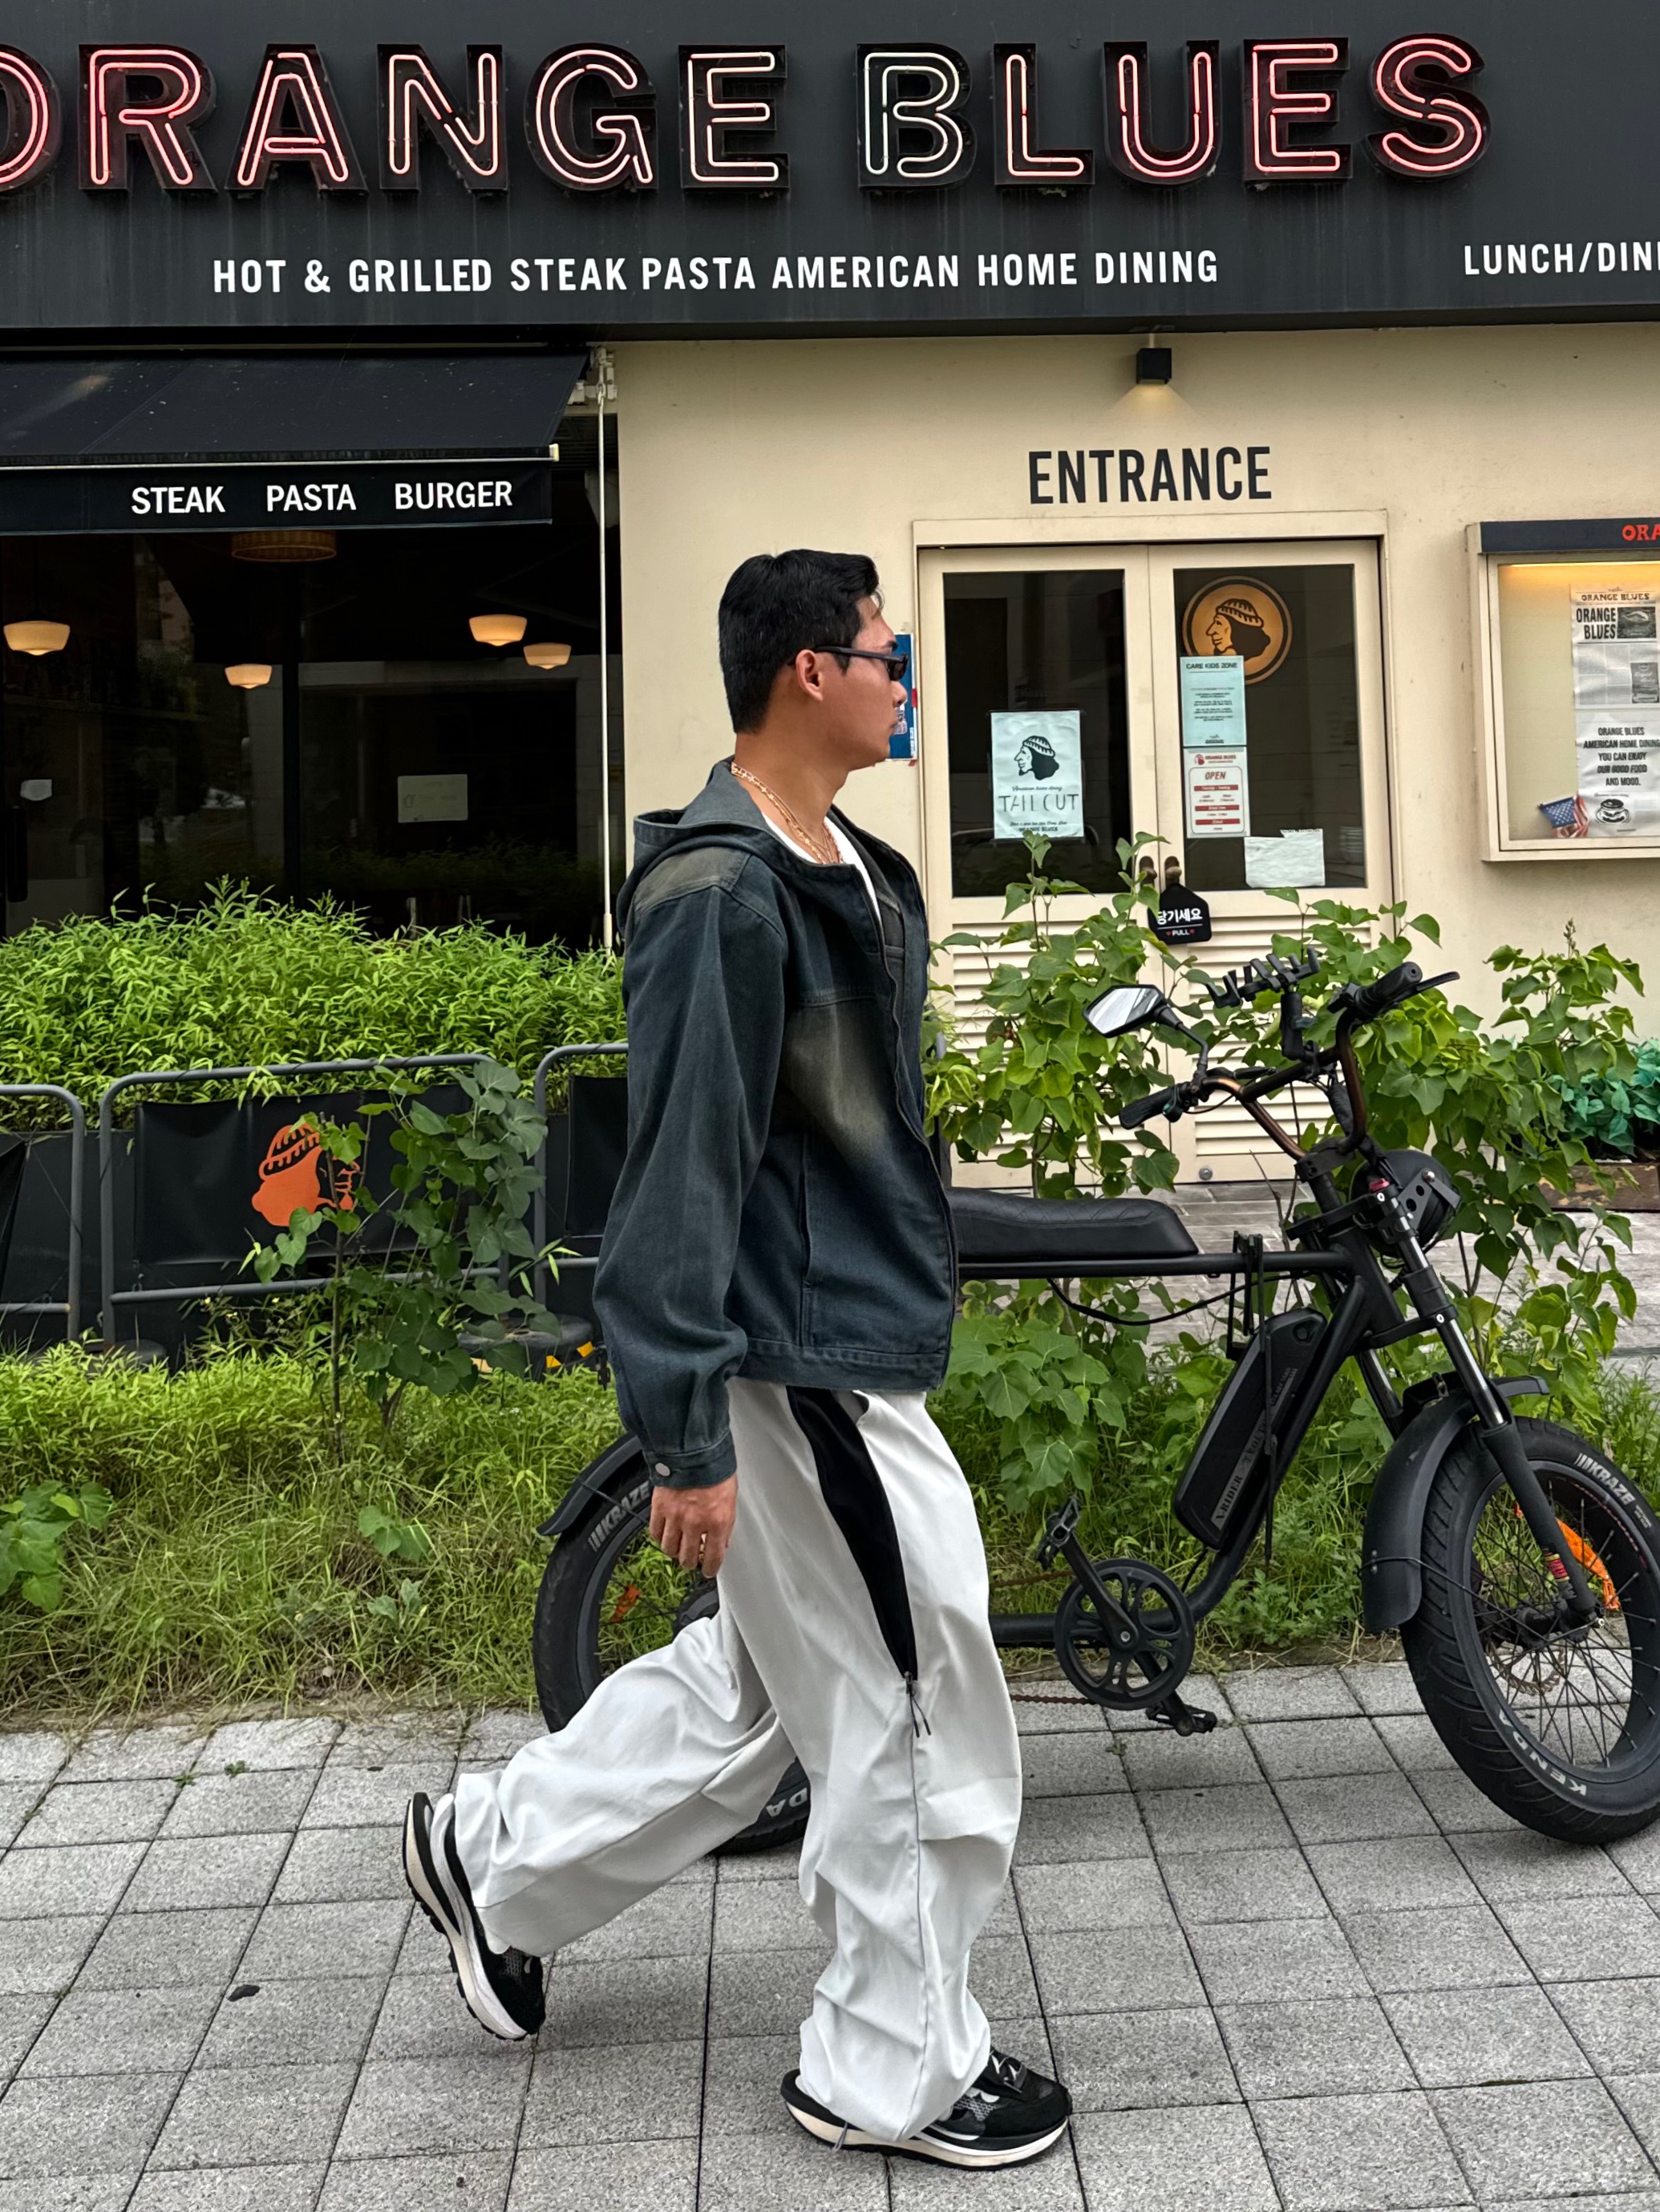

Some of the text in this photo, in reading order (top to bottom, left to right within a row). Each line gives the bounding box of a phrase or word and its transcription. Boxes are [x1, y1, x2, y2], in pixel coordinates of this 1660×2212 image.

[856, 34, 1488, 189] BLUES
[1464, 241, 1660, 275] LUNCH/DIN
[213, 249, 1217, 294] HOT & GRILLED STEAK PASTA AMERICAN HOME DINING
[1029, 446, 1272, 504] ENTRANCE
[132, 480, 512, 515] STEAK PASTA BURGER
[1576, 607, 1616, 623] ORANGE
[1584, 623, 1616, 640] BLUES
[1597, 727, 1645, 735] ORANGE BLUES
[1583, 739, 1618, 748] AMERICAN
[1618, 739, 1638, 748] HOME
[1597, 752, 1648, 761] YOU CAN ENJOY
[1205, 772, 1226, 780] OPEN
[1597, 765, 1611, 774] OUR
[1630, 764, 1647, 773] FOOD
[1605, 777, 1619, 786] AND
[1157, 908, 1203, 926] 당기세요
[1172, 929, 1190, 937] PULL
[1586, 1459, 1636, 1505] KRAZE
[599, 1481, 650, 1537] KRAZE
[1499, 1708, 1587, 1796] KENDA
